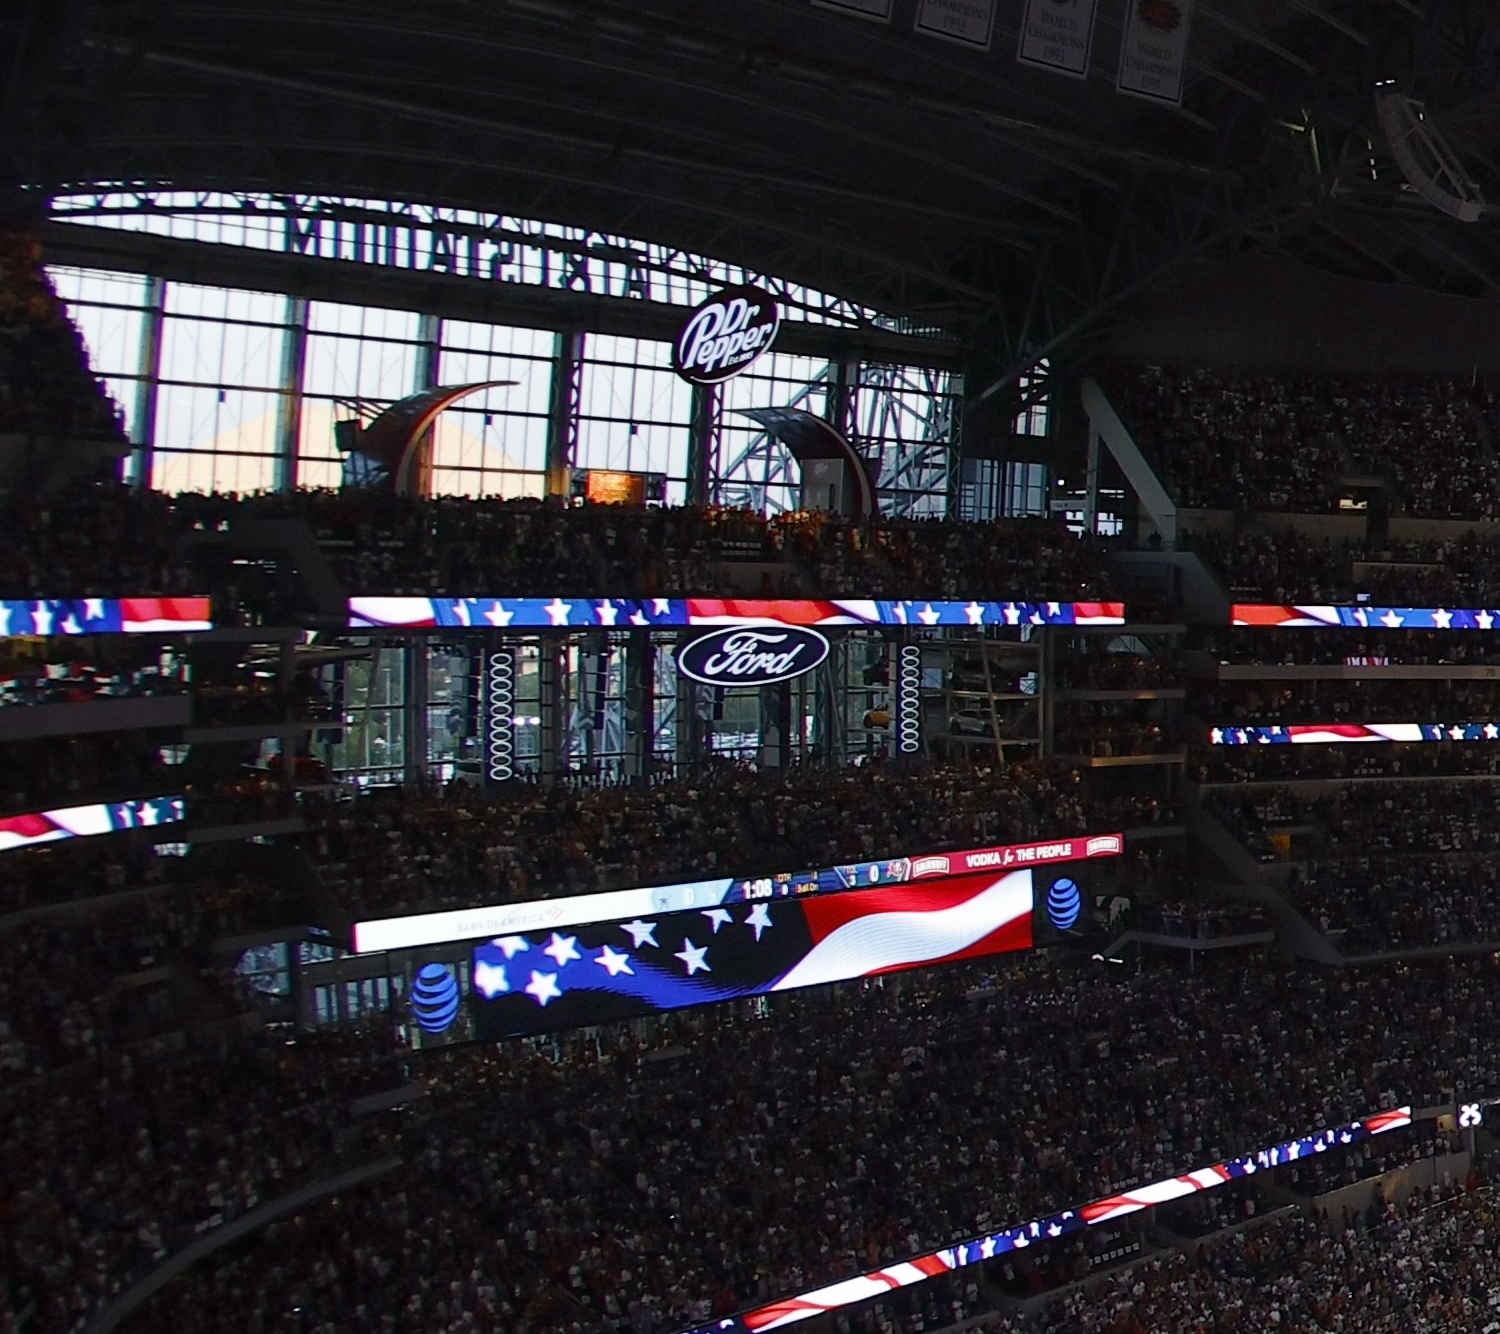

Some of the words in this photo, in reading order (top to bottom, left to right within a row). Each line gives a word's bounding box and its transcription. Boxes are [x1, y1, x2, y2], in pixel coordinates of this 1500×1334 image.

[718, 298, 761, 336] Dr
[704, 631, 806, 675] Ford
[965, 853, 1001, 868] VODKA
[1015, 847, 1035, 862] THE
[1036, 843, 1072, 859] PEOPLE
[868, 865, 880, 882] 0
[743, 879, 773, 900] 1:08
[1459, 1104, 1482, 1128] 25
